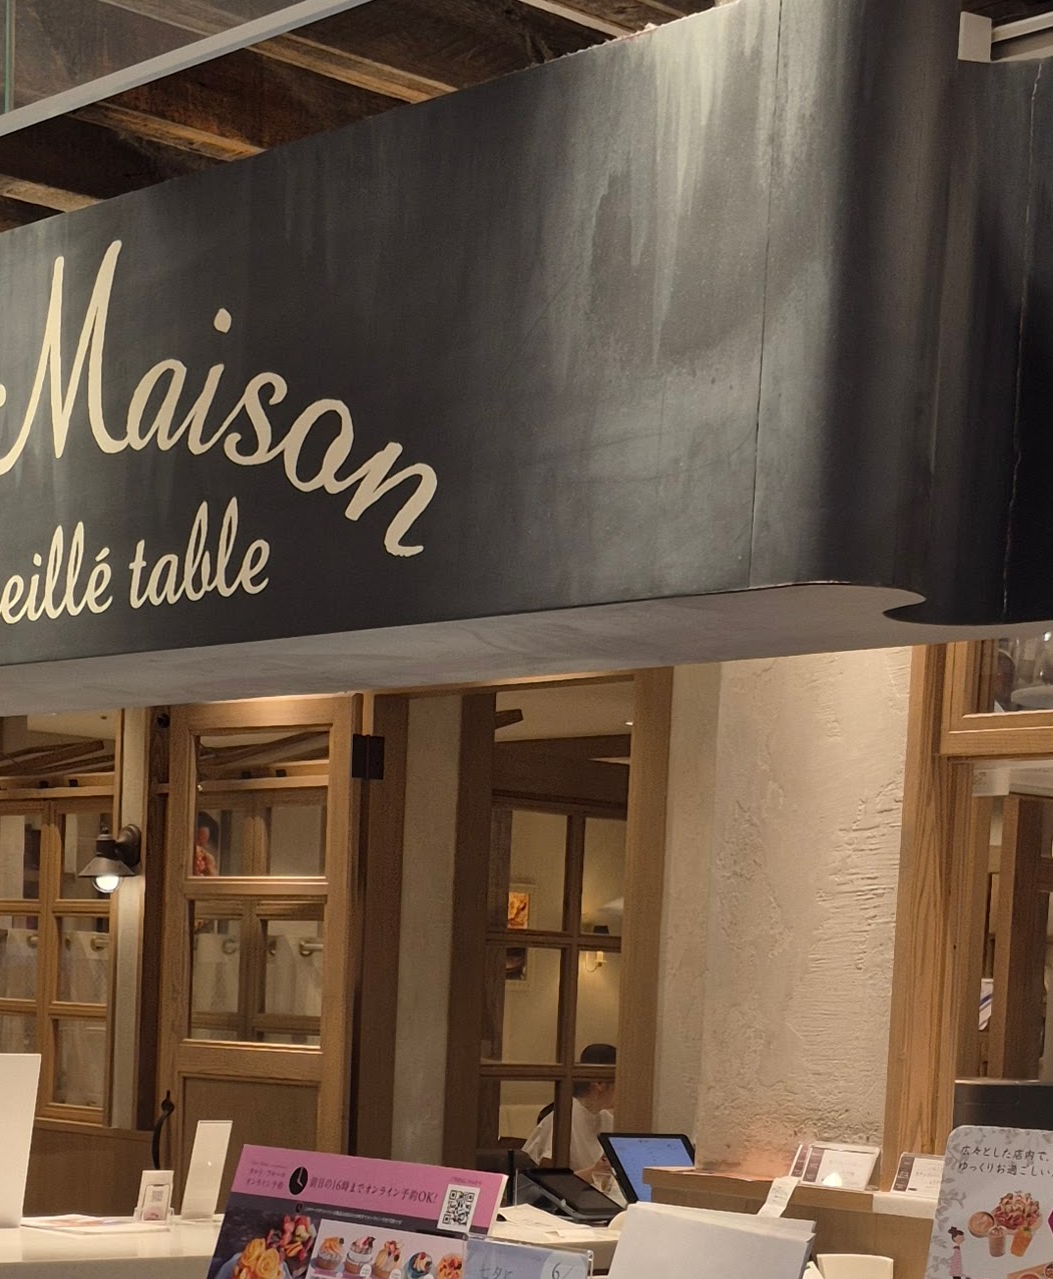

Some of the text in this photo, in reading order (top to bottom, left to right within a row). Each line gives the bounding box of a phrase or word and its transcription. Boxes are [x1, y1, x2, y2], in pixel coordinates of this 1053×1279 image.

[129, 497, 270, 606] table
[958, 1161, 1053, 1177] ゆっくりお過ごしい
